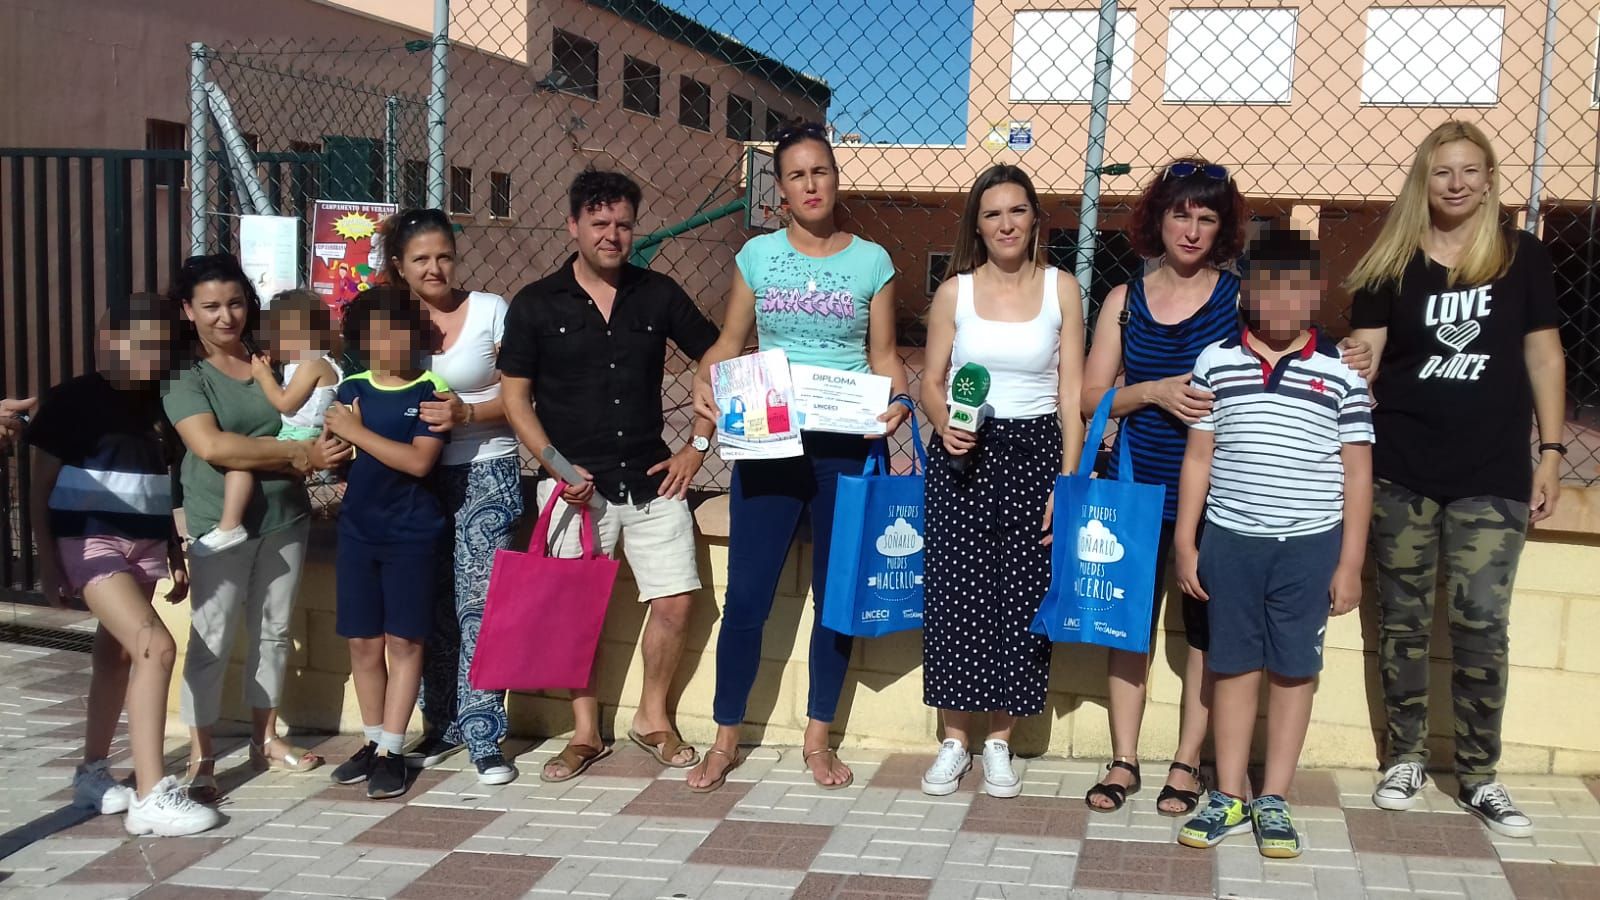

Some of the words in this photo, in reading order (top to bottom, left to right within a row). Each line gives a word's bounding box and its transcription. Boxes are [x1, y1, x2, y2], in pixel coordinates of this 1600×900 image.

[322, 203, 360, 211] CAMPAMENTO
[1425, 284, 1492, 326] LOVE
[1418, 353, 1491, 380] DANCE
[812, 373, 857, 386] DIPLOMA
[813, 403, 839, 411] LINCECI
[888, 505, 896, 518] SI
[895, 505, 919, 518] PUEDES
[1088, 505, 1117, 522] PUEDES
[883, 531, 916, 549] SOÑARLO
[1080, 535, 1116, 557] OÑARLO
[887, 557, 908, 569] PUEDES
[876, 571, 915, 589] HACERLO
[1078, 577, 1113, 601] CERLO
[862, 609, 890, 620] LINCECI
